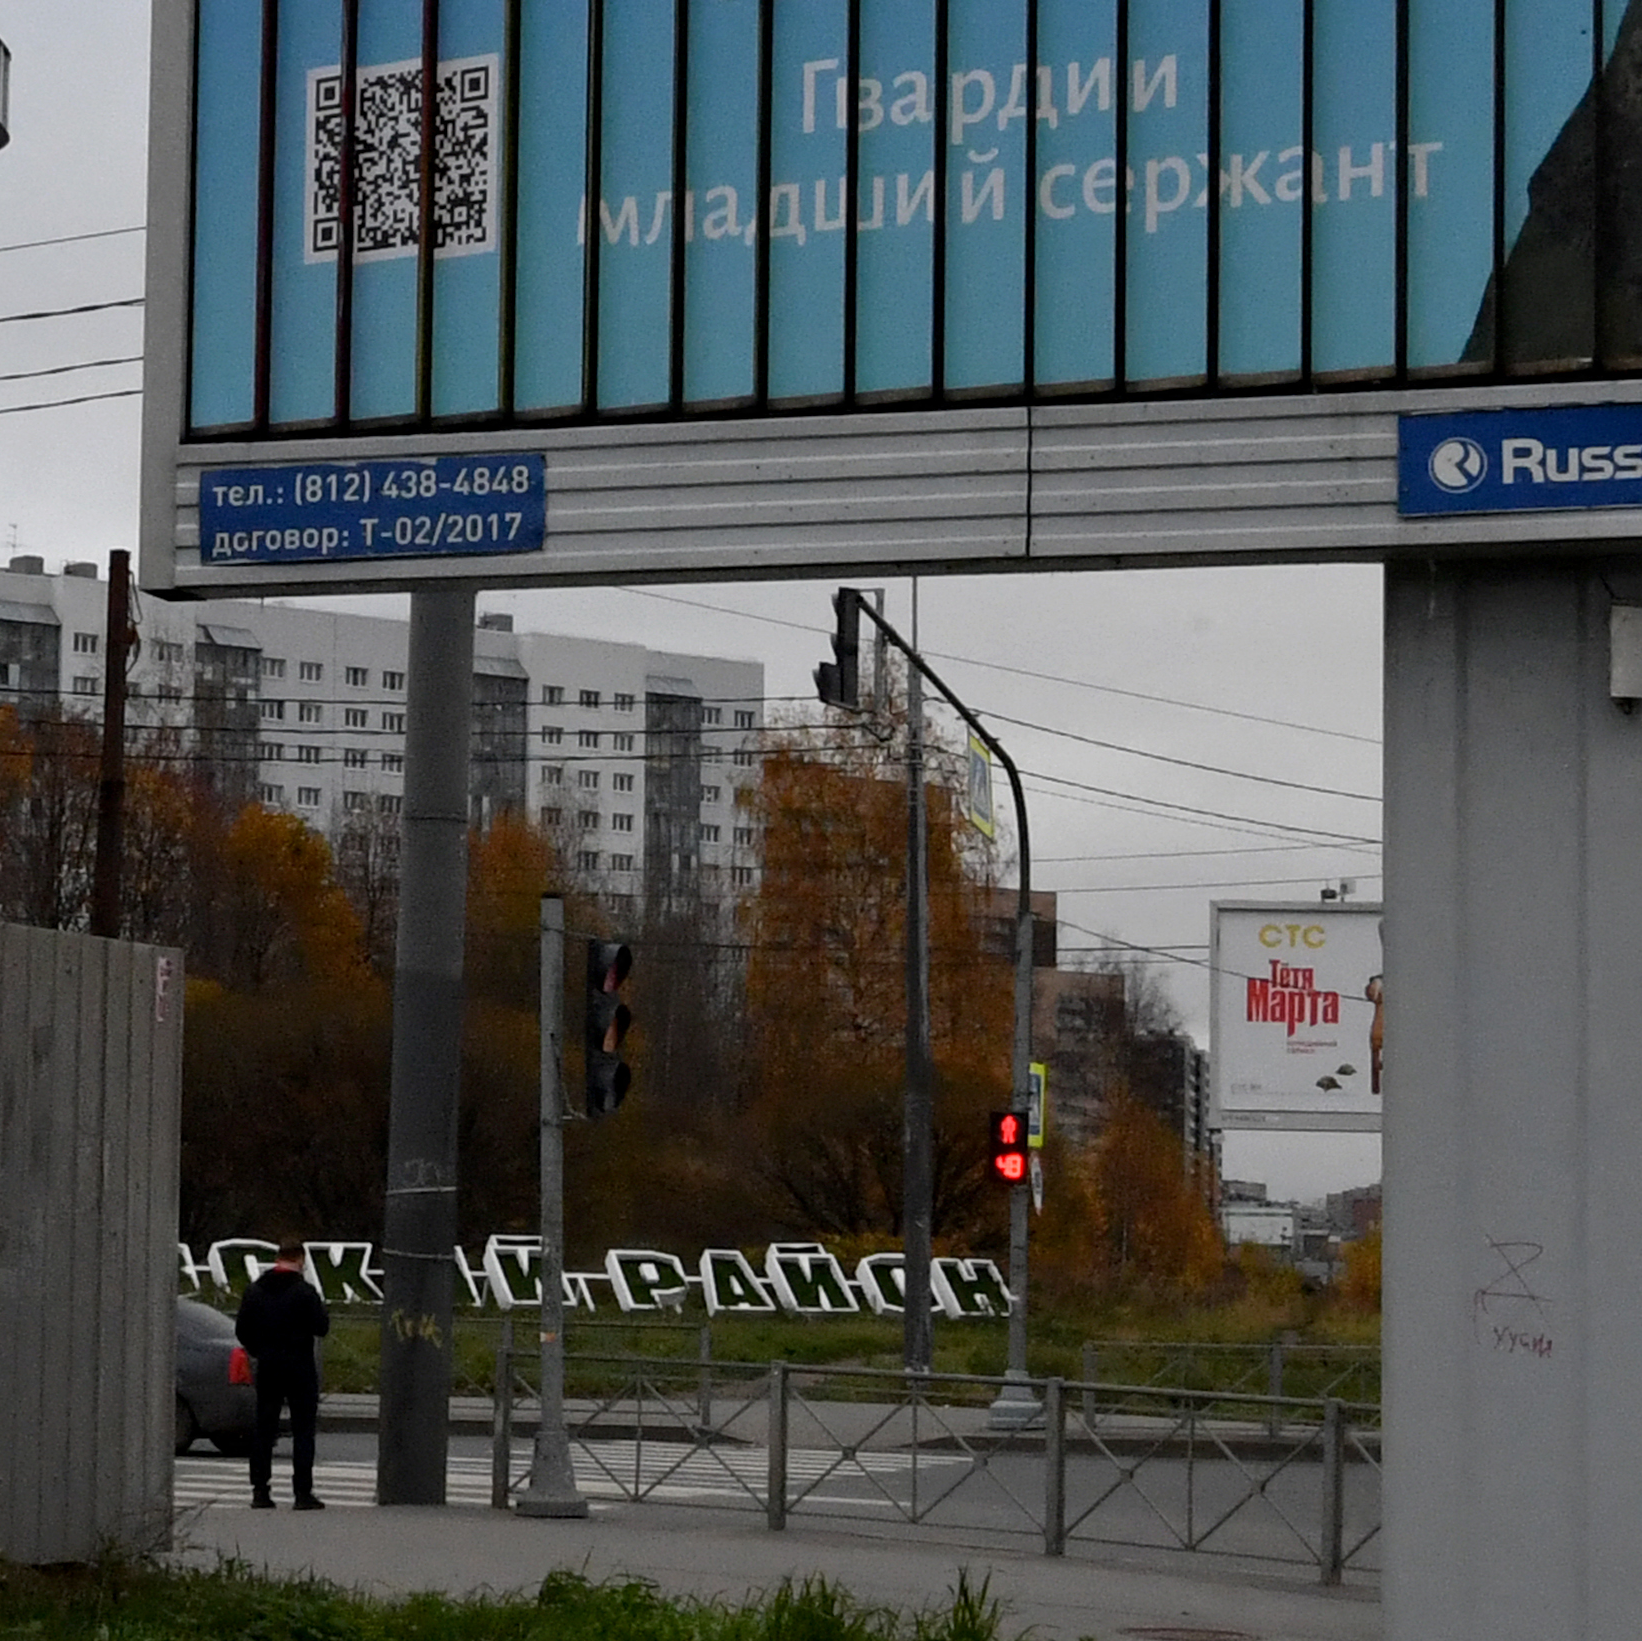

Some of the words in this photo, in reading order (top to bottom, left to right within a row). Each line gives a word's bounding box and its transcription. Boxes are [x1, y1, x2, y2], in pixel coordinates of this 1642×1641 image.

[801, 54, 1179, 143] Гвардии
[577, 149, 1005, 248] младший
[1040, 140, 1444, 233] сержант
[212, 482, 284, 507] тел.:
[294, 470, 371, 506] (812)
[382, 465, 530, 499] 438-4848
[212, 526, 350, 558] договор:
[360, 511, 523, 548] Т-02/2017
[1259, 924, 1325, 948] СТС
[1247, 977, 1339, 1038] Марта
[605, 1242, 1013, 1319] РАЙОН
